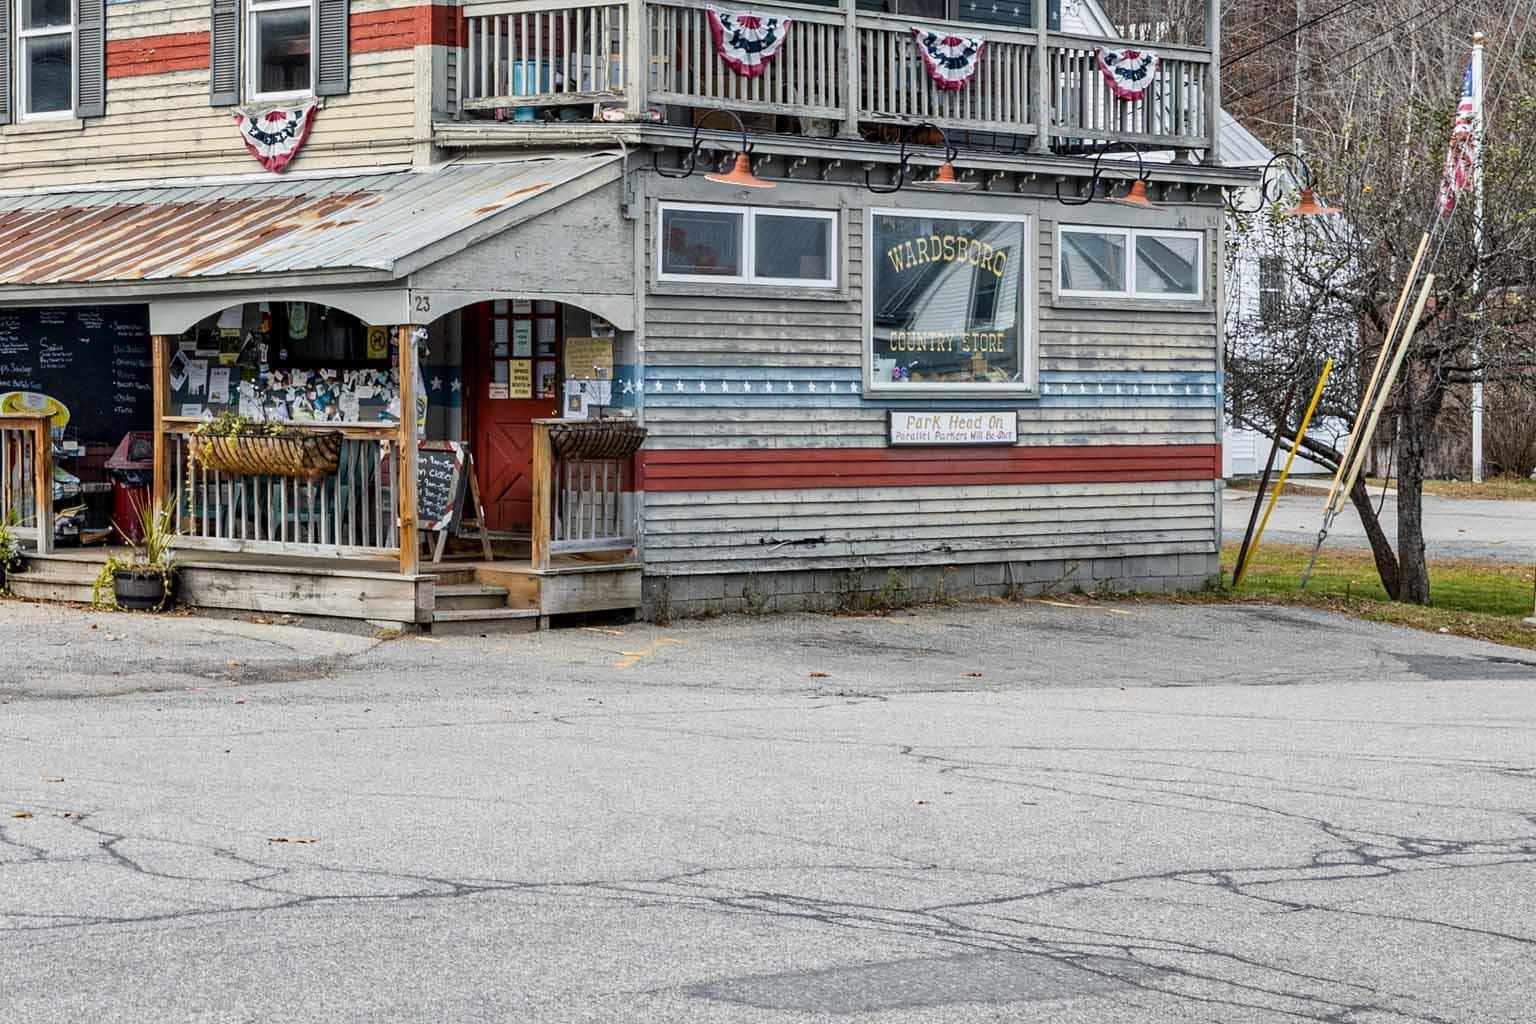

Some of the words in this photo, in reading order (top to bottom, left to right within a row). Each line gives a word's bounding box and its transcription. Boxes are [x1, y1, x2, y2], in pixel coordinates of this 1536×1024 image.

[887, 234, 1007, 278] WARDSBORO
[414, 296, 431, 313] 23
[889, 331, 955, 352] COUNTRY
[960, 333, 1005, 353] STORE
[949, 415, 983, 430] Head
[988, 415, 1004, 430] On
[896, 431, 930, 441] Parallel
[970, 431, 983, 440] Will
